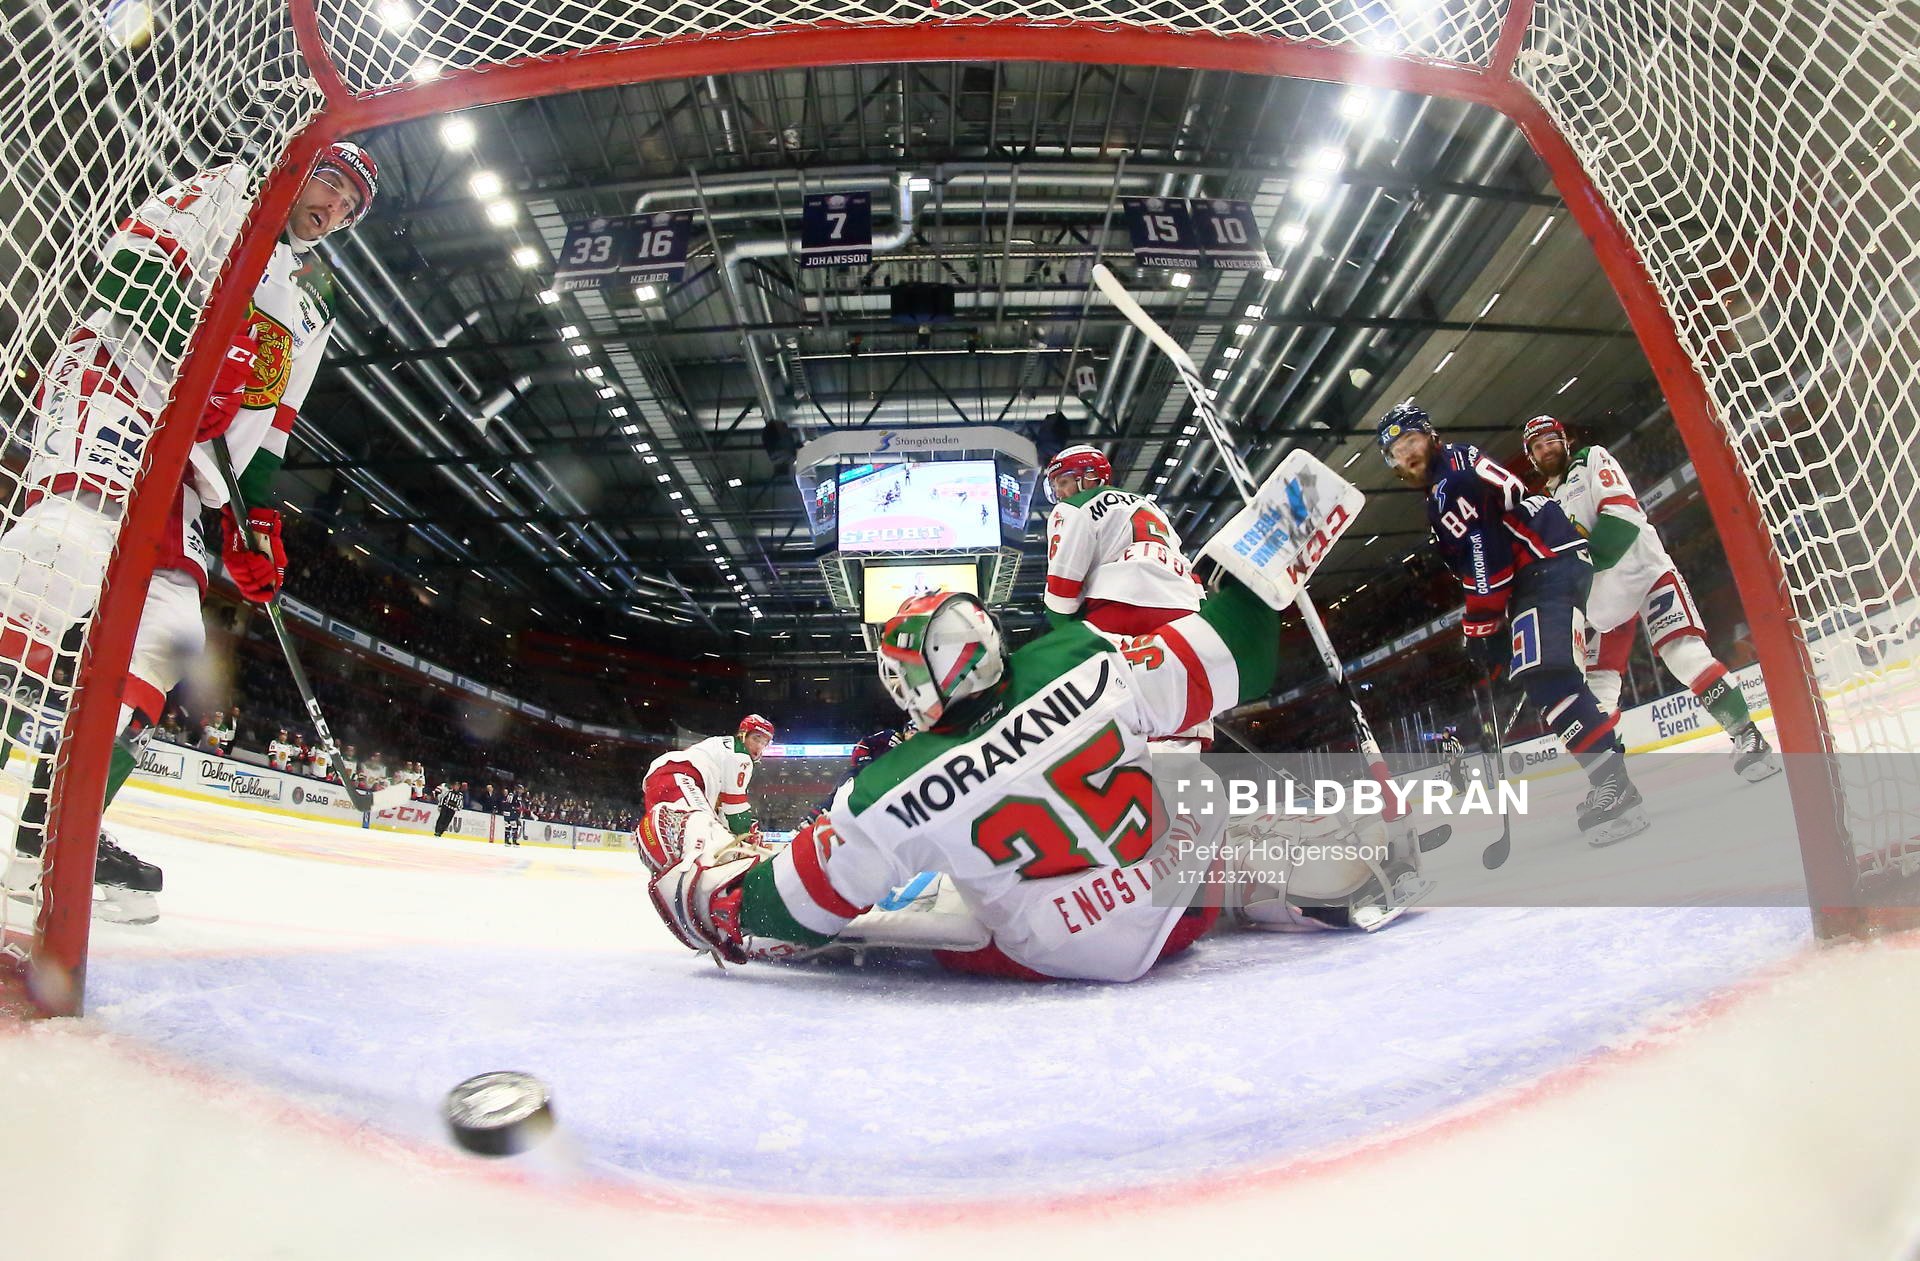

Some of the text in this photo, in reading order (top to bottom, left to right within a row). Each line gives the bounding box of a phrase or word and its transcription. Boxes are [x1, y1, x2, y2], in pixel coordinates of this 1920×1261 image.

[826, 212, 847, 239] 7
[1143, 215, 1179, 242] 15
[1211, 217, 1248, 244] 10
[569, 235, 613, 264] 33
[638, 230, 674, 258] 16
[805, 253, 868, 266] JOHANSSON
[1143, 256, 1199, 268] JACOBSSON
[630, 272, 670, 284] HELBER
[1598, 468, 1624, 488] 91
[1440, 495, 1479, 539] 84
[1286, 504, 1350, 585] CCM
[1469, 532, 1489, 595] GOLVKOMFORT
[1651, 694, 1701, 722] ActiPro
[1658, 712, 1700, 739] Event
[1525, 747, 1559, 766] SAAB
[201, 759, 234, 783] Dekor
[305, 793, 329, 805] SAAB
[376, 805, 432, 824] CCM
